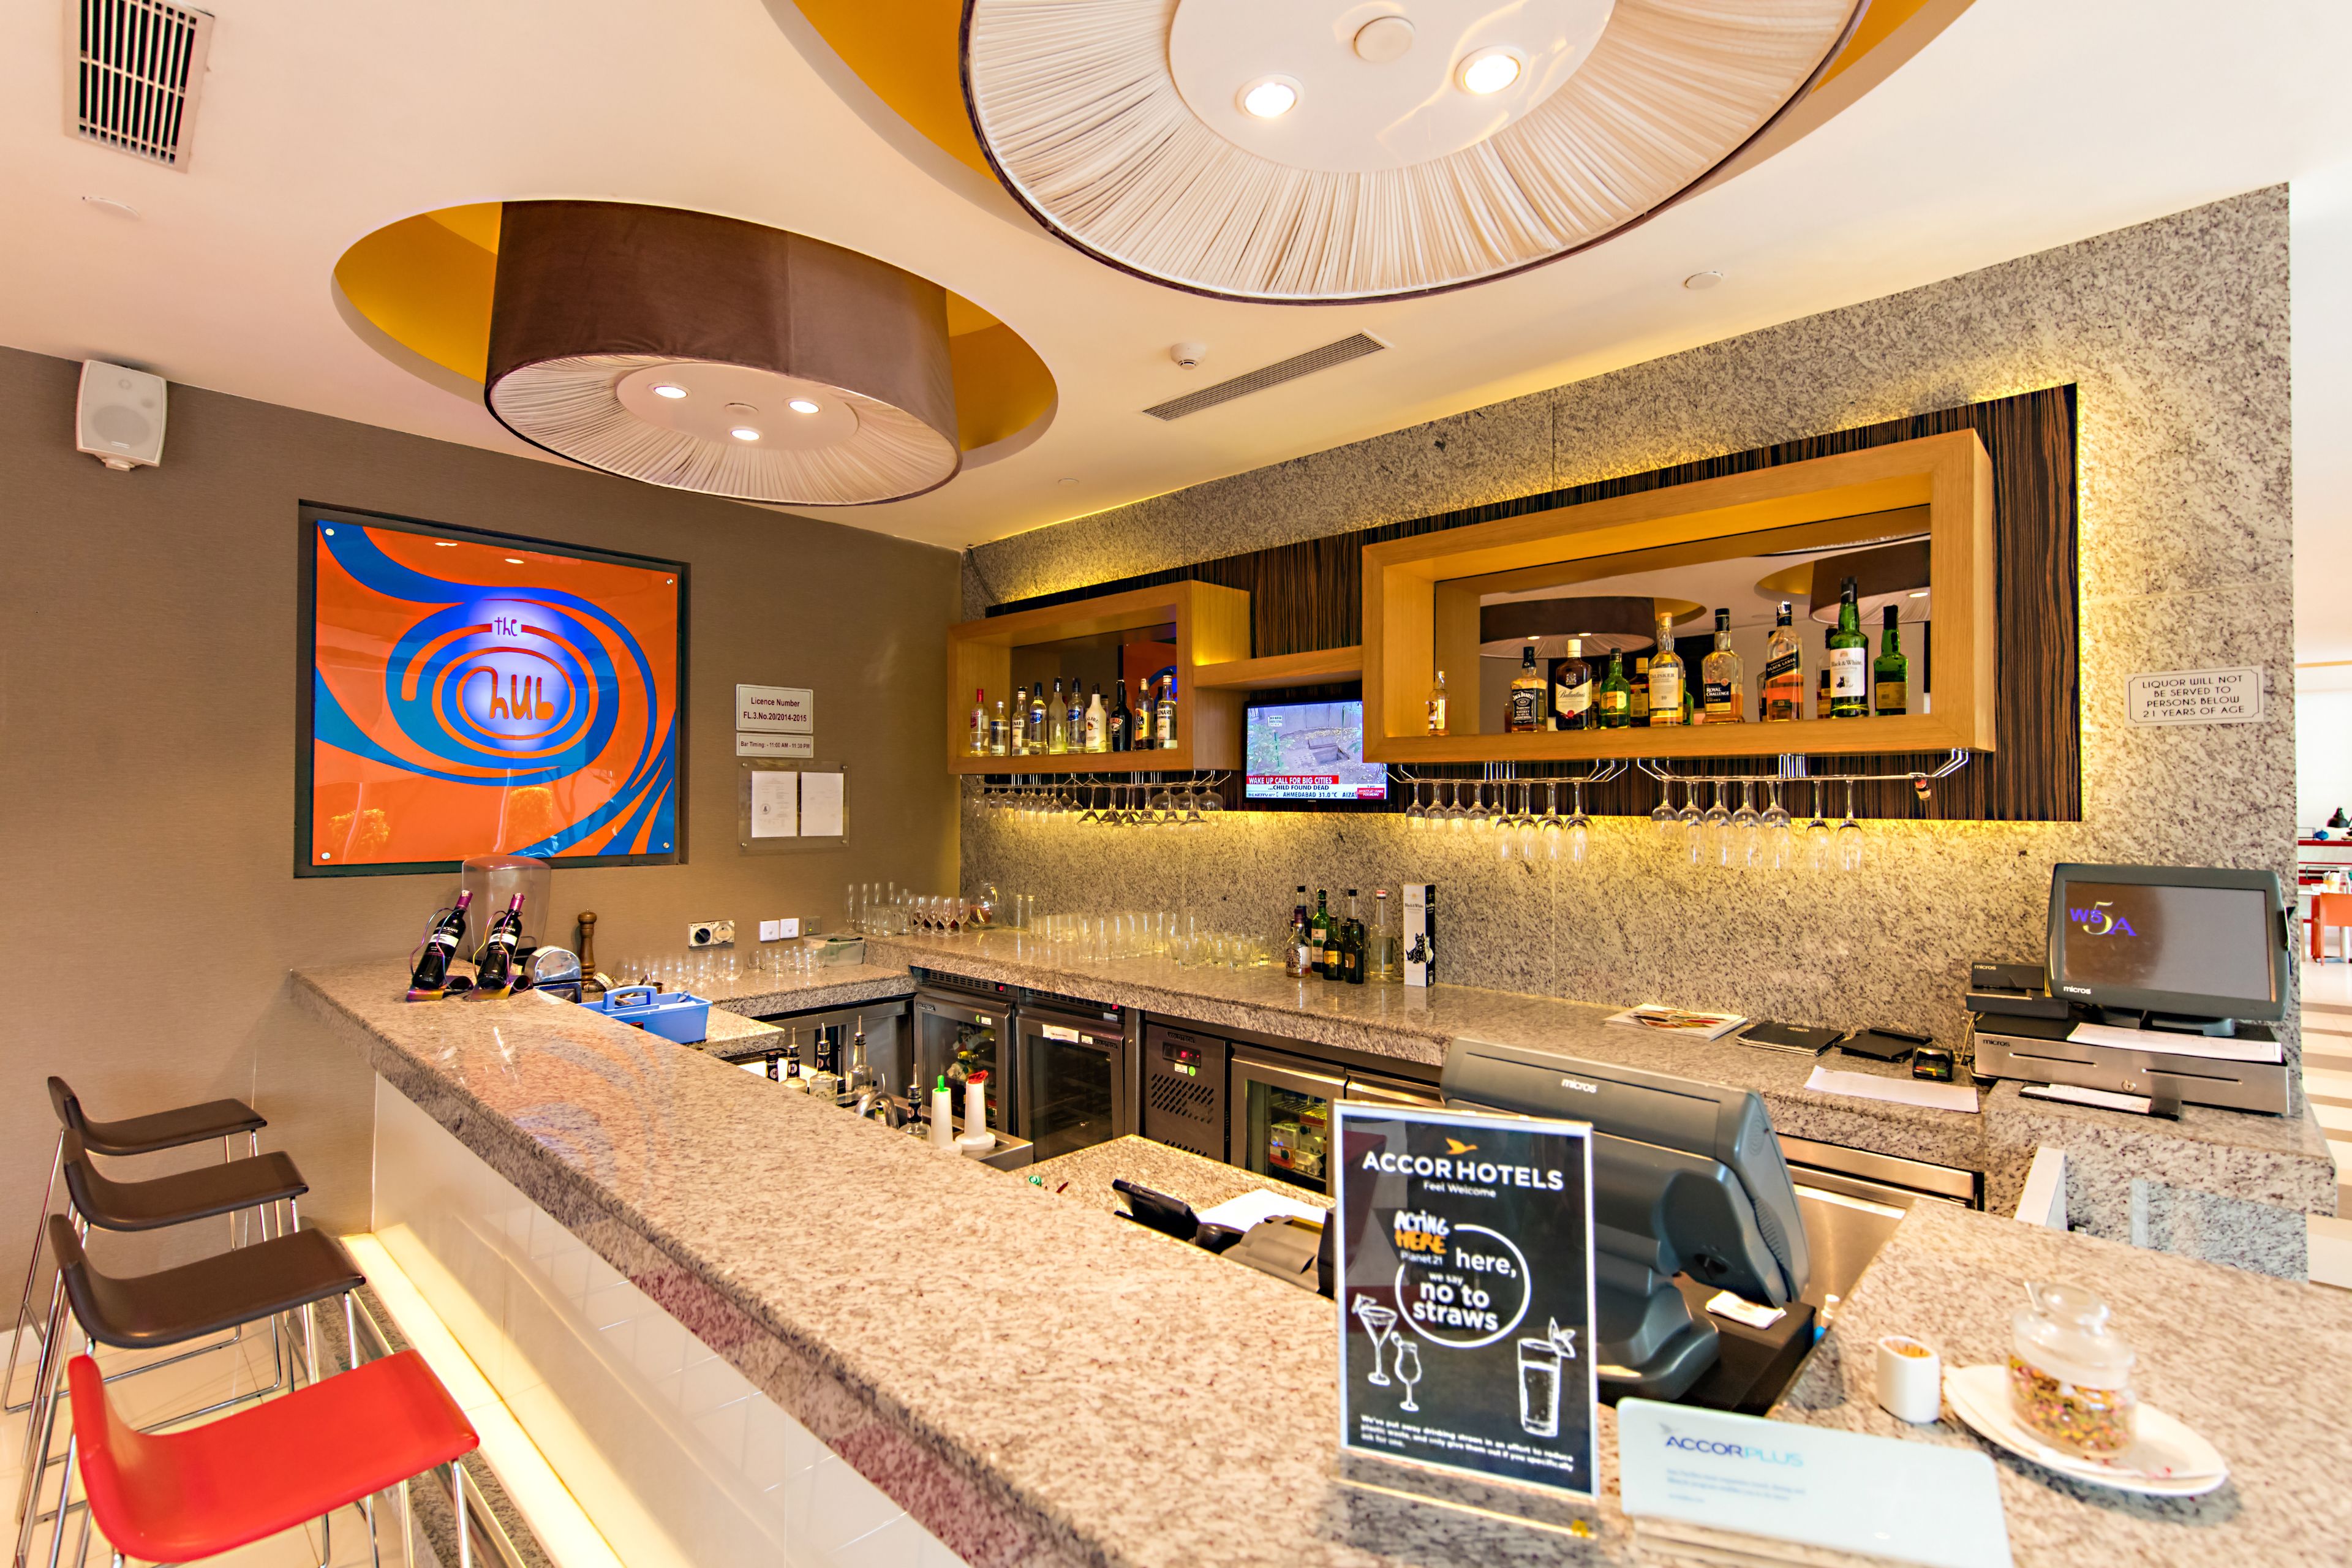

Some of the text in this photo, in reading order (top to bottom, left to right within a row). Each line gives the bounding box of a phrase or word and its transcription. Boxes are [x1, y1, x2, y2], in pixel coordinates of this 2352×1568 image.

[494, 617, 518, 637] the
[2143, 675, 2243, 689] LIQUOR WILL NOT
[484, 665, 555, 721] hub
[2170, 688, 2211, 697] SERVED
[751, 697, 800, 707] Licence Number
[2147, 696, 2240, 708] PERSONS BELOW
[743, 711, 807, 722] FL.3.No.20/2014-2015
[2162, 708, 2196, 717] YEARS
[2221, 706, 2245, 714] AGE
[2063, 986, 2092, 995] micros
[1983, 1038, 2011, 1047] micros
[1561, 1079, 1598, 1094] micros
[1362, 1150, 1565, 1191] ACCOR HOTELS
[1423, 1180, 1497, 1199] Feel Welcome
[1394, 1229, 1447, 1255] HERE
[1400, 1250, 1444, 1266] Planet 21
[1455, 1246, 1517, 1279] here,
[1428, 1271, 1464, 1286] we say
[1420, 1281, 1490, 1309] no to
[1412, 1300, 1499, 1332] straws
[1423, 1427, 1456, 1441] drinking
[1457, 1433, 1483, 1445] straws
